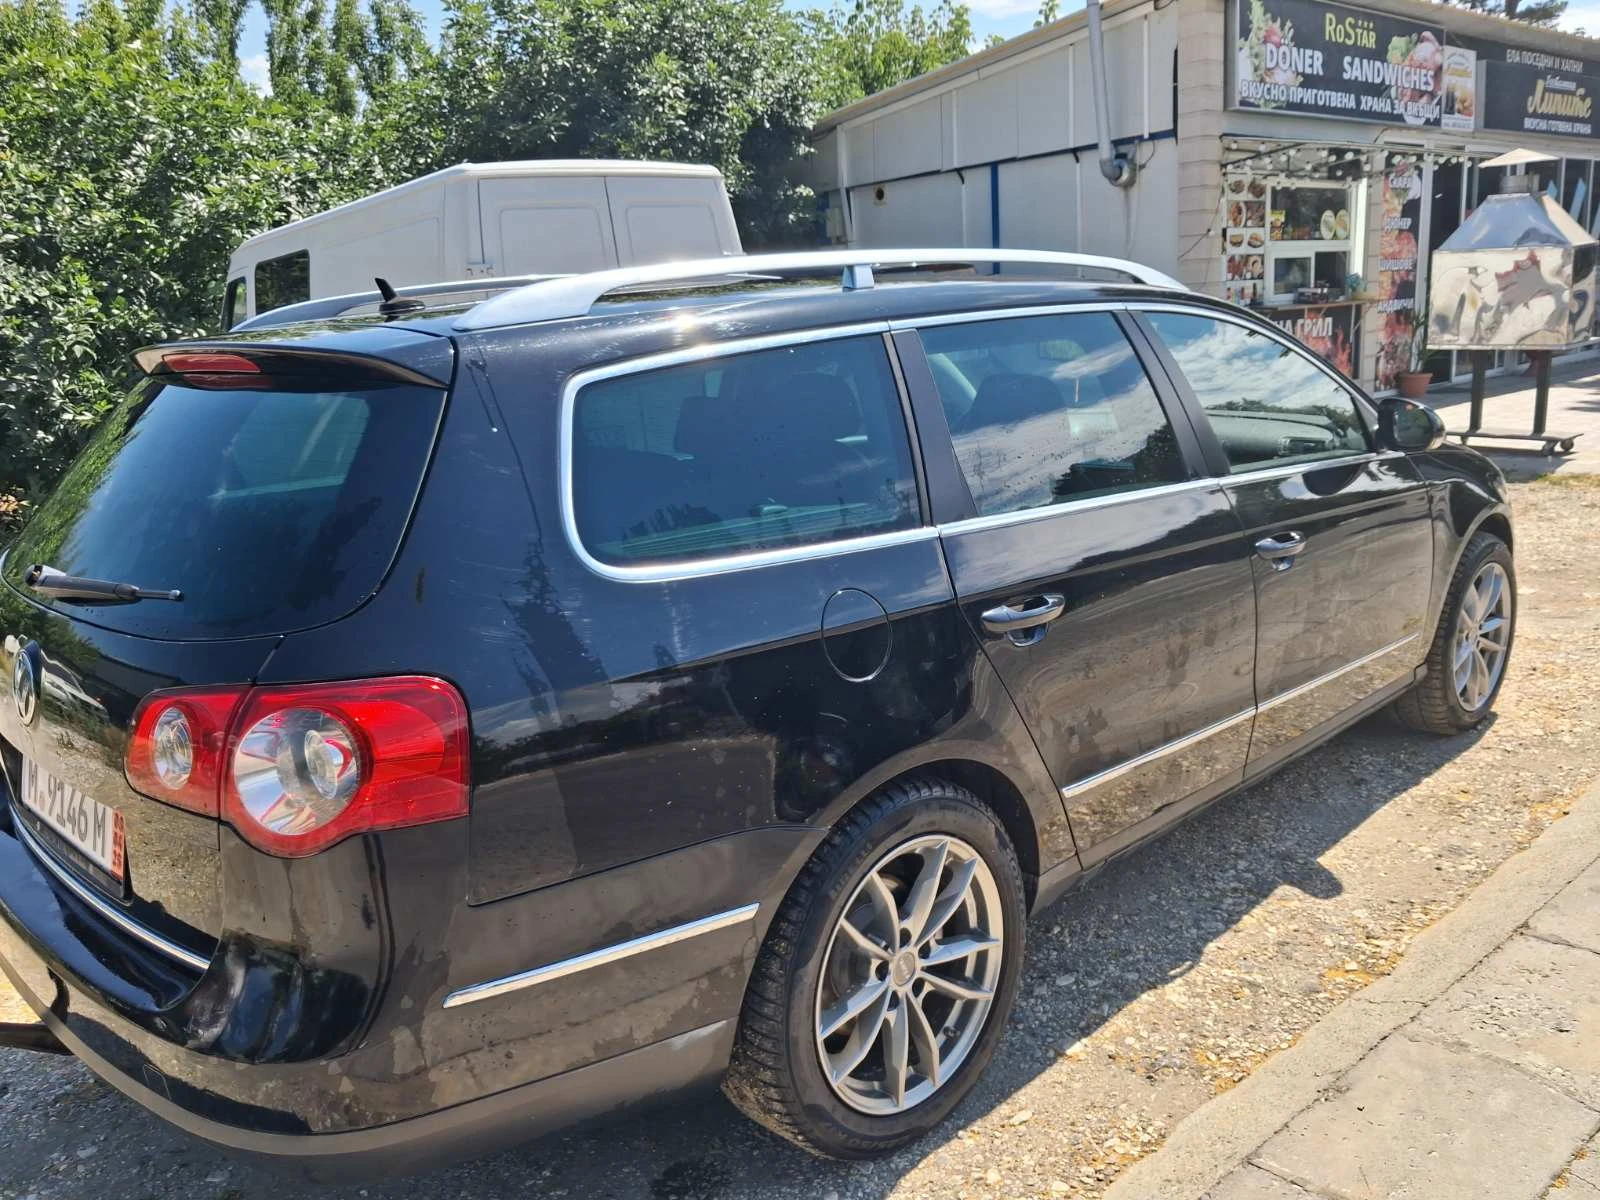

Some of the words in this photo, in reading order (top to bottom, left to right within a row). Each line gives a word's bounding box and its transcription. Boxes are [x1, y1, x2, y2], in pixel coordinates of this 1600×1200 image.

[1265, 38, 1324, 76] DÖNER
[1342, 55, 1434, 93] SANDWICHES
[1521, 51, 1553, 71] ПОСЕДНИ
[1240, 79, 1287, 102] ВКУСНО
[1289, 87, 1357, 110] ПРИГОТВЕНА
[1360, 96, 1392, 114] ХРАНА
[1393, 102, 1406, 116] ЗА
[1295, 317, 1333, 338] ГРИЛ
[47, 773, 88, 842] 9146
[93, 799, 107, 859] M
